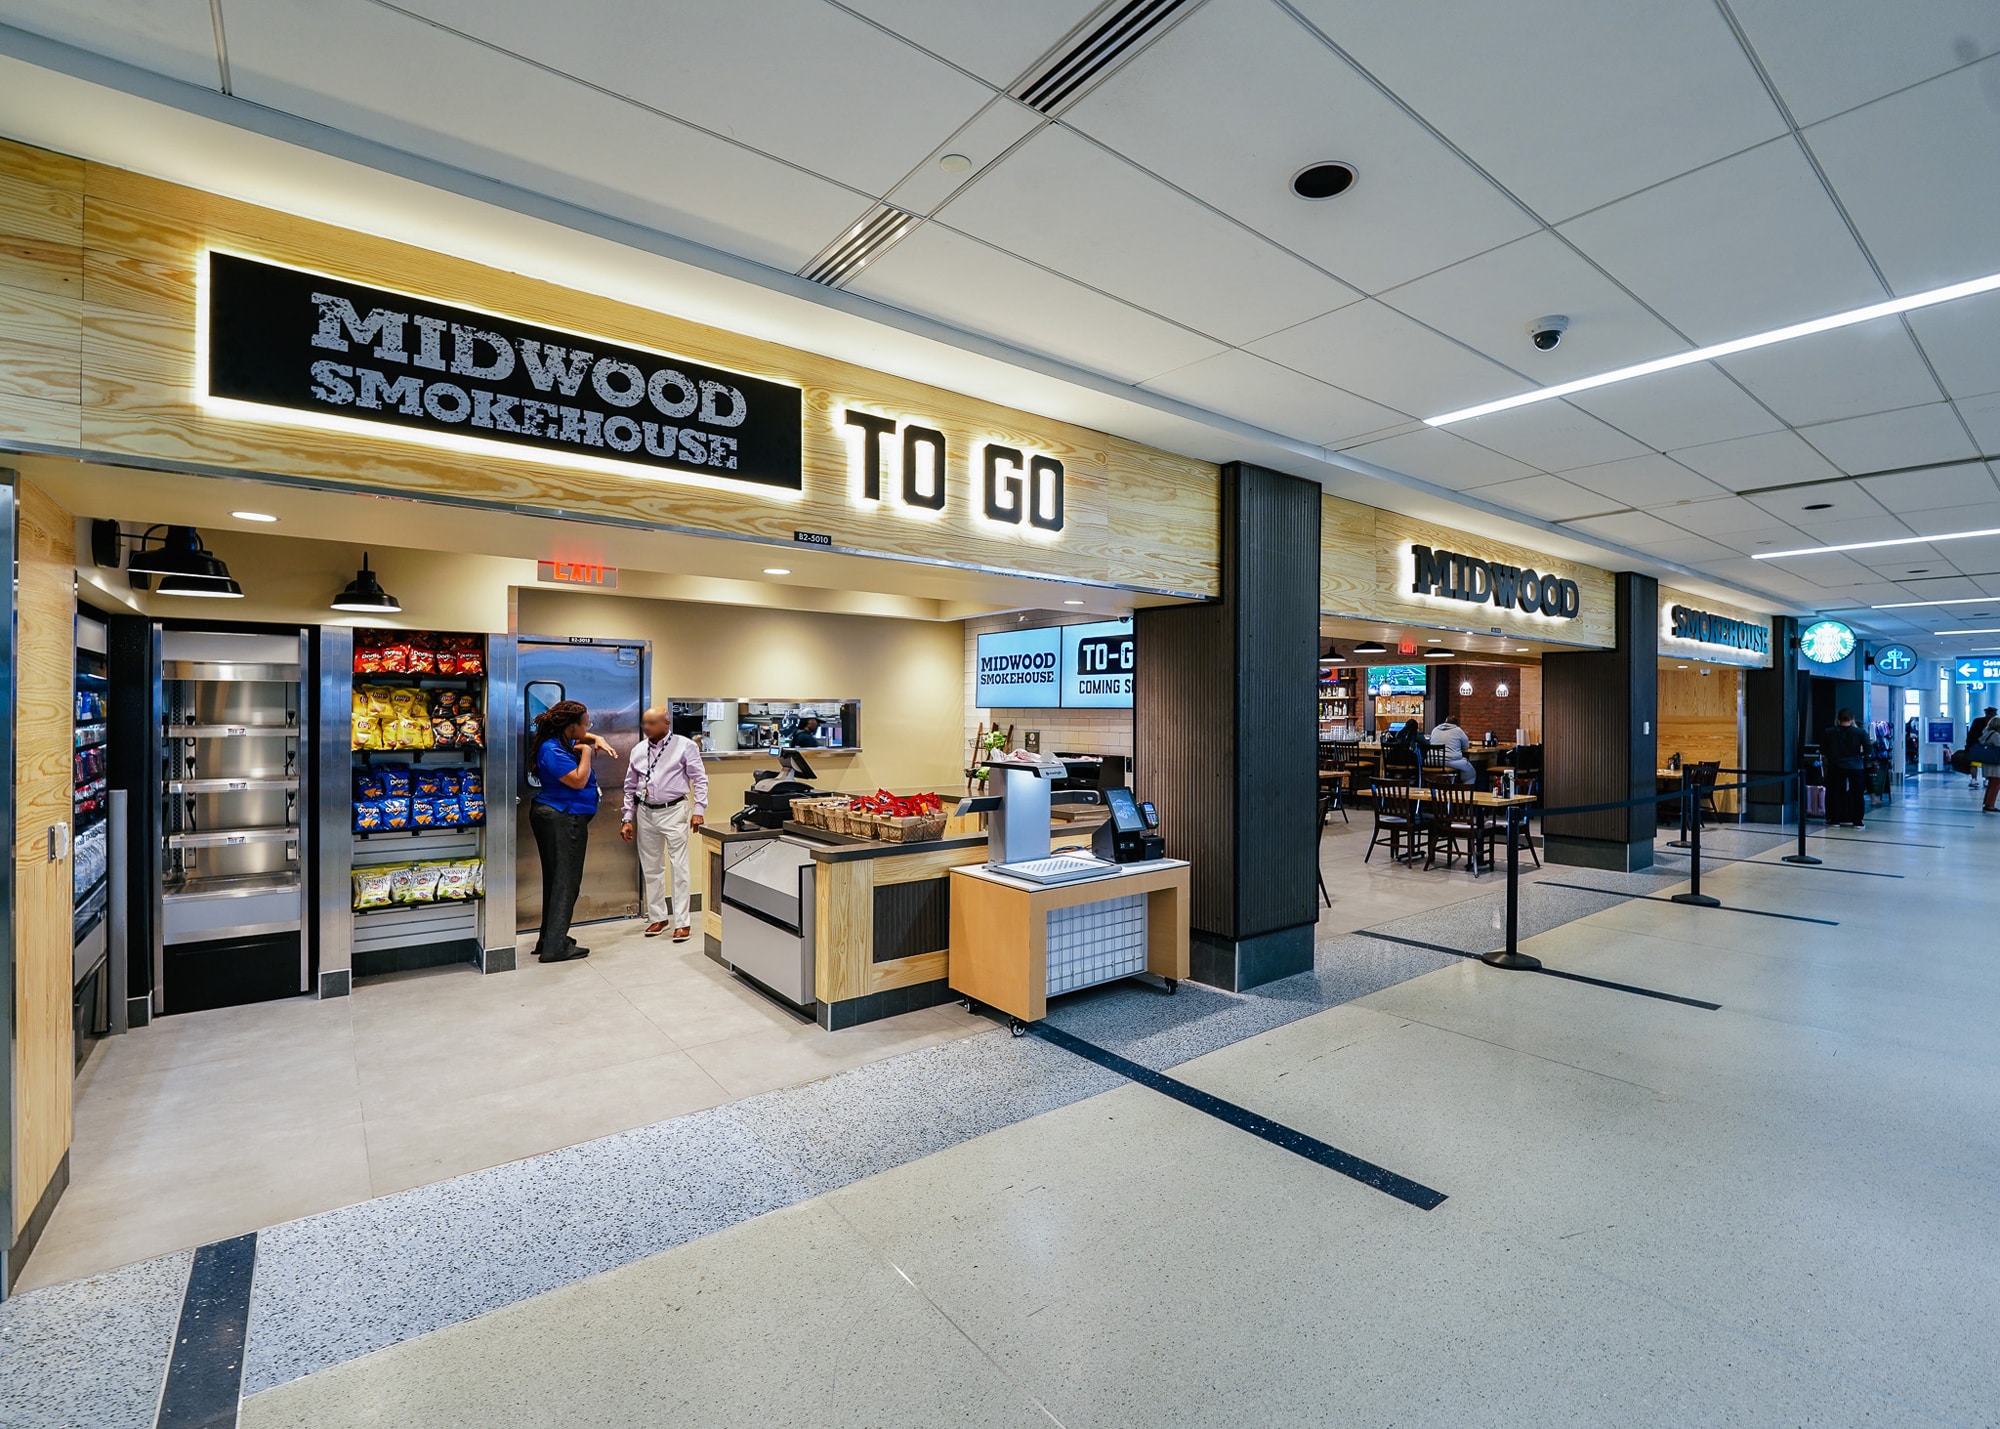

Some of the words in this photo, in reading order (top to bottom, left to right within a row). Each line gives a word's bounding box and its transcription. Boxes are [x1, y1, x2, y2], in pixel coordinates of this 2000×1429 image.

[311, 292, 747, 428] MIDWOOD
[310, 359, 739, 471] SMOKEHOUSE
[845, 409, 946, 511] TO
[983, 443, 1064, 532] GO
[798, 533, 829, 544] B2-5010
[1411, 544, 1579, 619] MIDWOOD
[1671, 604, 1768, 653] SMOKEHOUSE
[981, 653, 1056, 672] MIDWOOD
[1880, 657, 1911, 670] CLT
[980, 671, 1055, 685] SMOKEHOUSE
[1983, 668, 2000, 677] B1
[1079, 679, 1120, 694] COMING
